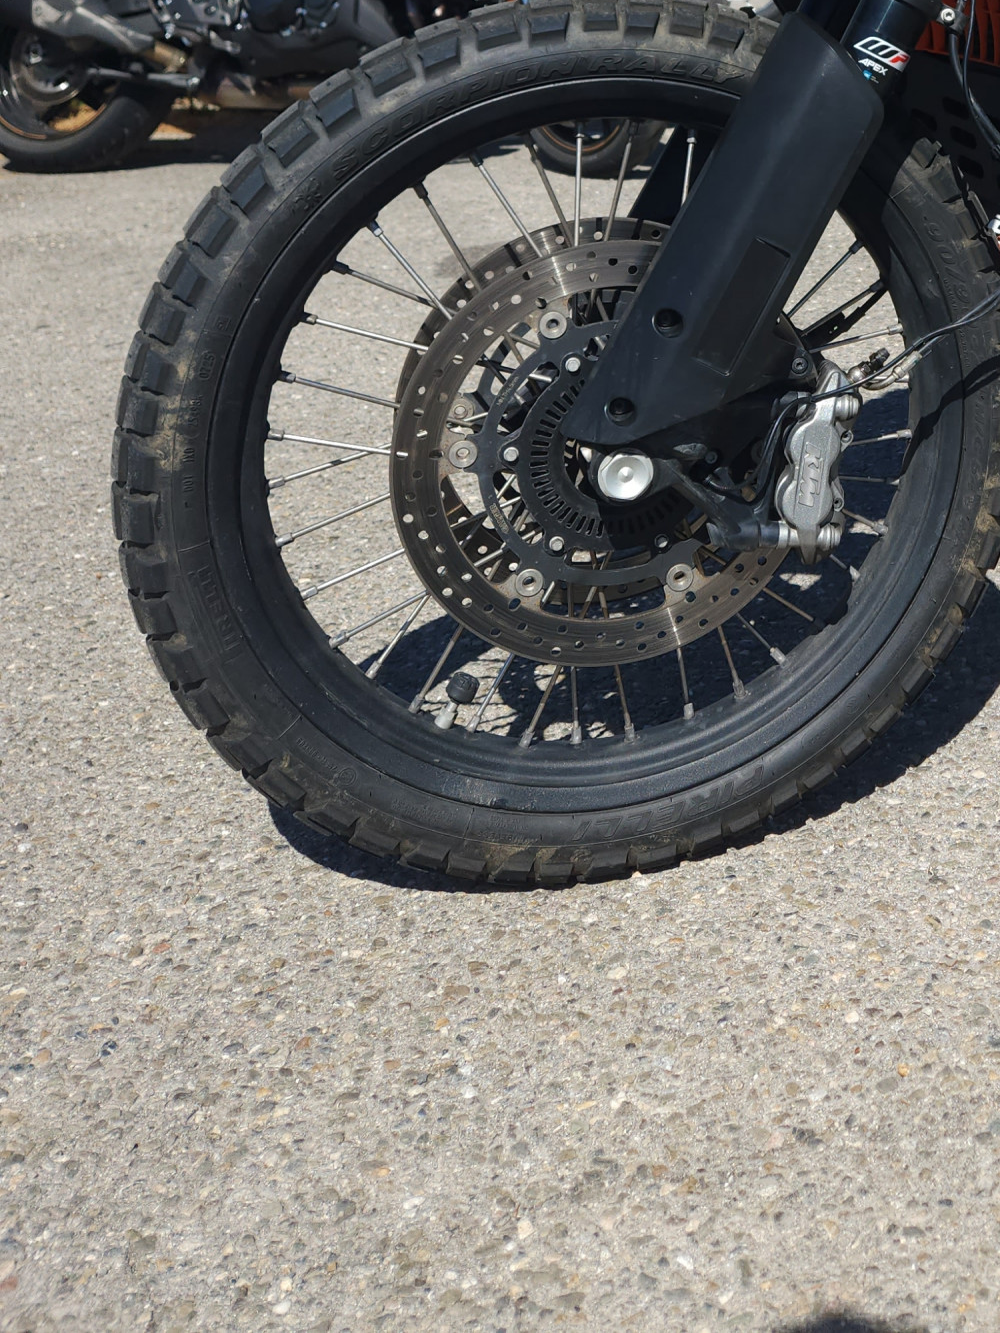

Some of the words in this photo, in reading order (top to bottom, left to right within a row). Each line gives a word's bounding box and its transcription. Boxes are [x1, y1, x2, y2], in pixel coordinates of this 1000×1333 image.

[858, 58, 888, 76] APEX
[333, 53, 577, 182] SCORPION
[588, 54, 745, 85] RALLY
[798, 441, 824, 508] KTM
[571, 765, 765, 842] PIRELLI
